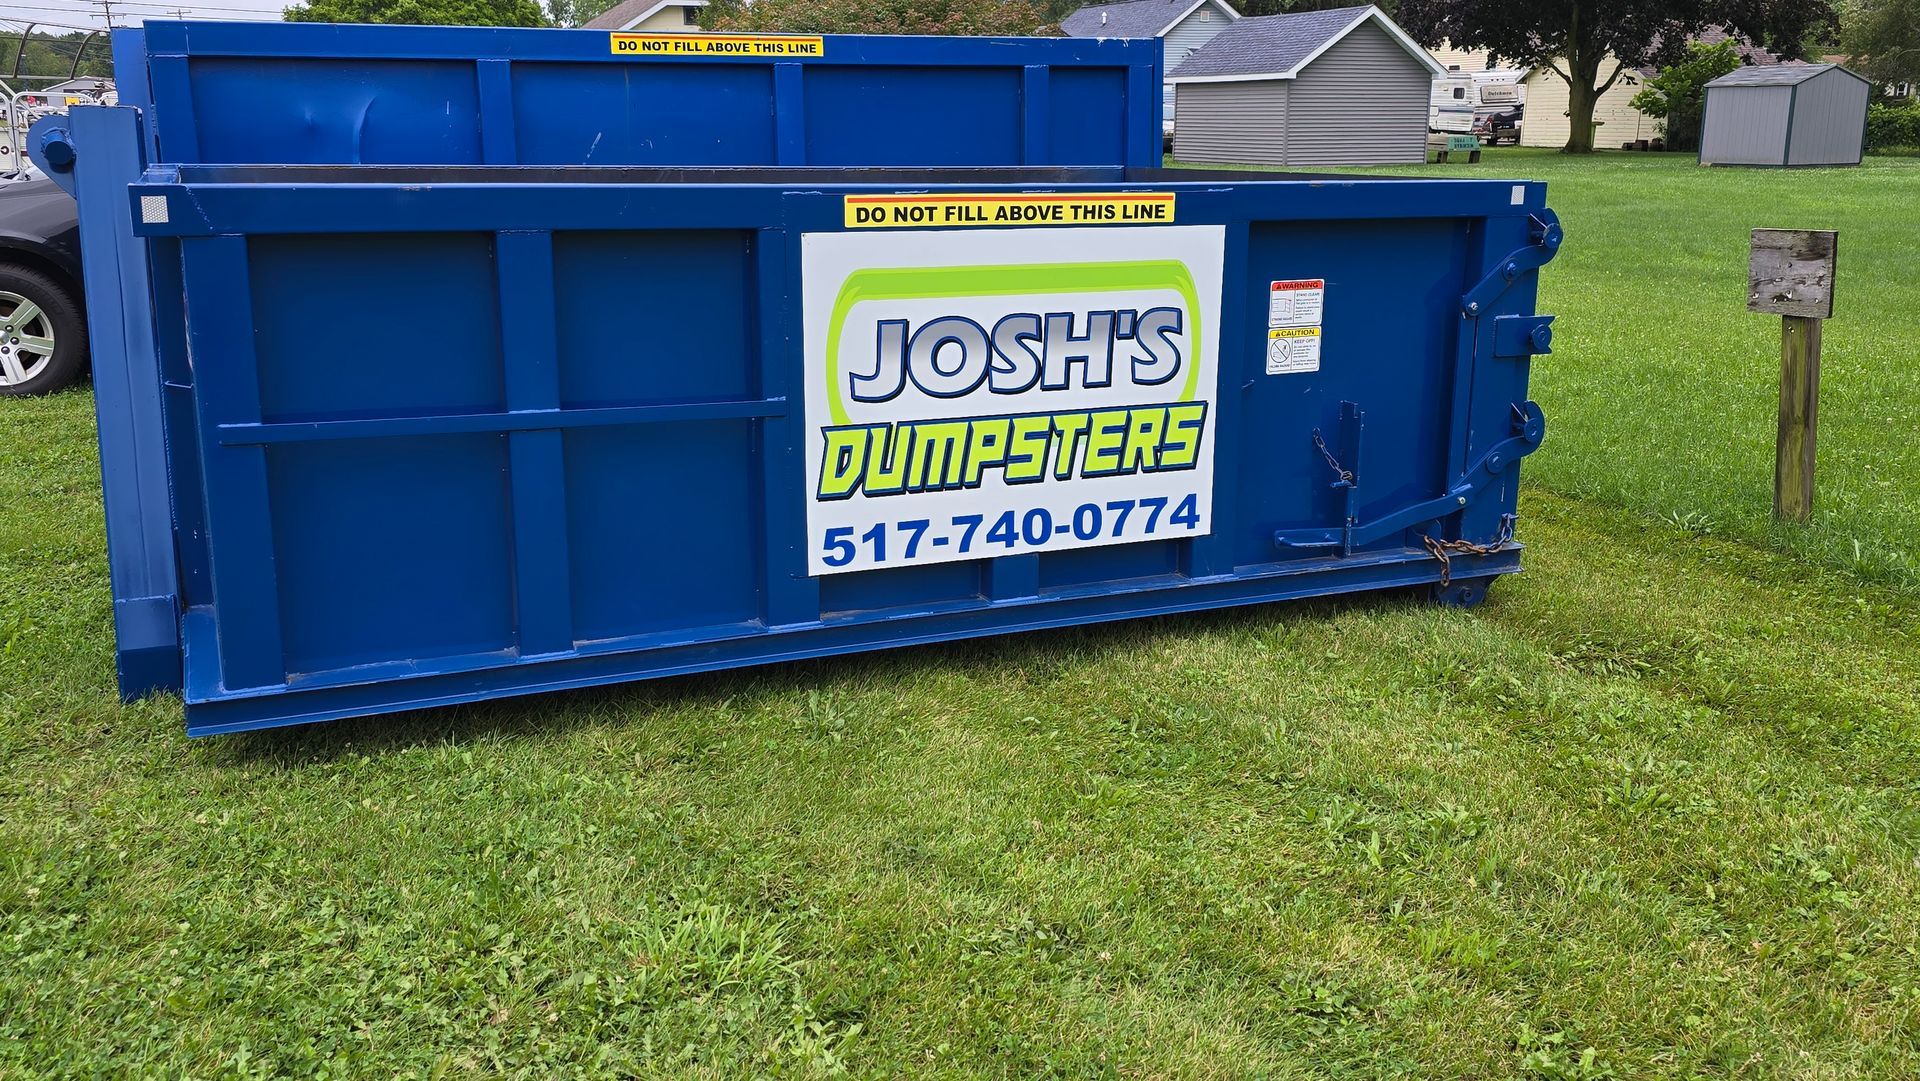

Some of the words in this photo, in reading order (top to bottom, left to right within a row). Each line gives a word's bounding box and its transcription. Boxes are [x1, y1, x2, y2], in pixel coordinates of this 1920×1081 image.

[618, 41, 637, 51] DO
[642, 41, 670, 51] NOT
[674, 41, 702, 52] FILL
[706, 42, 751, 52] ABOVE
[755, 43, 784, 53] THIS
[788, 43, 817, 53] LINE
[856, 207, 886, 223] DO
[893, 206, 938, 222] NOT
[944, 205, 989, 222] FILL
[994, 205, 1063, 221] ABOVE
[1069, 204, 1116, 220] THIS
[1122, 204, 1166, 219] LINE
[1282, 282, 1319, 290] WARNING
[1281, 329, 1315, 337] CAUTION
[849, 307, 1183, 403] JOSH'S
[816, 400, 1208, 502] DUMPSTERS
[821, 493, 1200, 568] 517-740-0774
